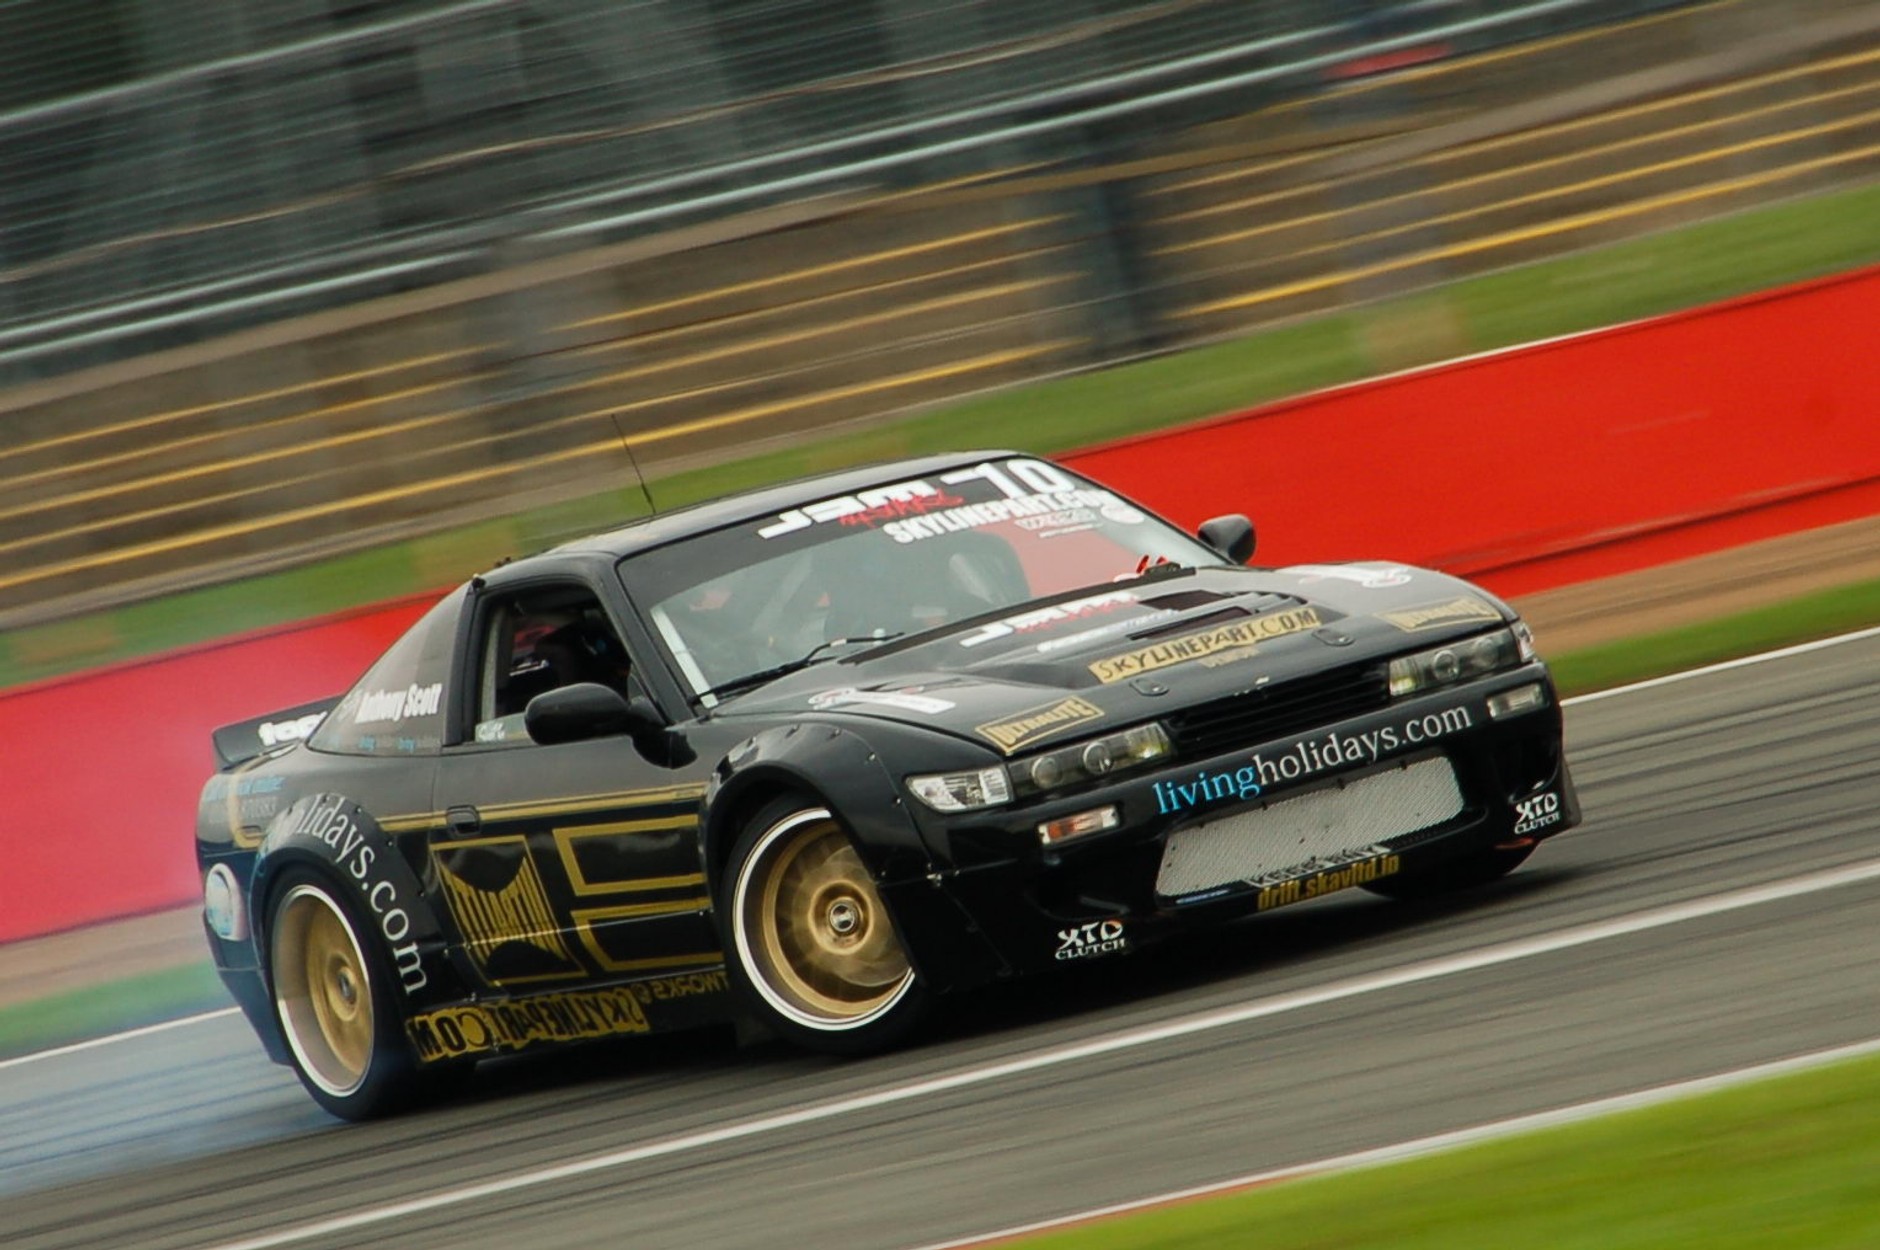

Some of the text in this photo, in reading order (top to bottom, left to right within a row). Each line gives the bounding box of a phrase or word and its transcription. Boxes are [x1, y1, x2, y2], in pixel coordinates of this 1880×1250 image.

[1098, 607, 1317, 681] SKYLINEPART.COM
[403, 683, 442, 718] Scott
[1153, 705, 1473, 814] livingholidays.com
[1054, 939, 1126, 961] CLUTCH
